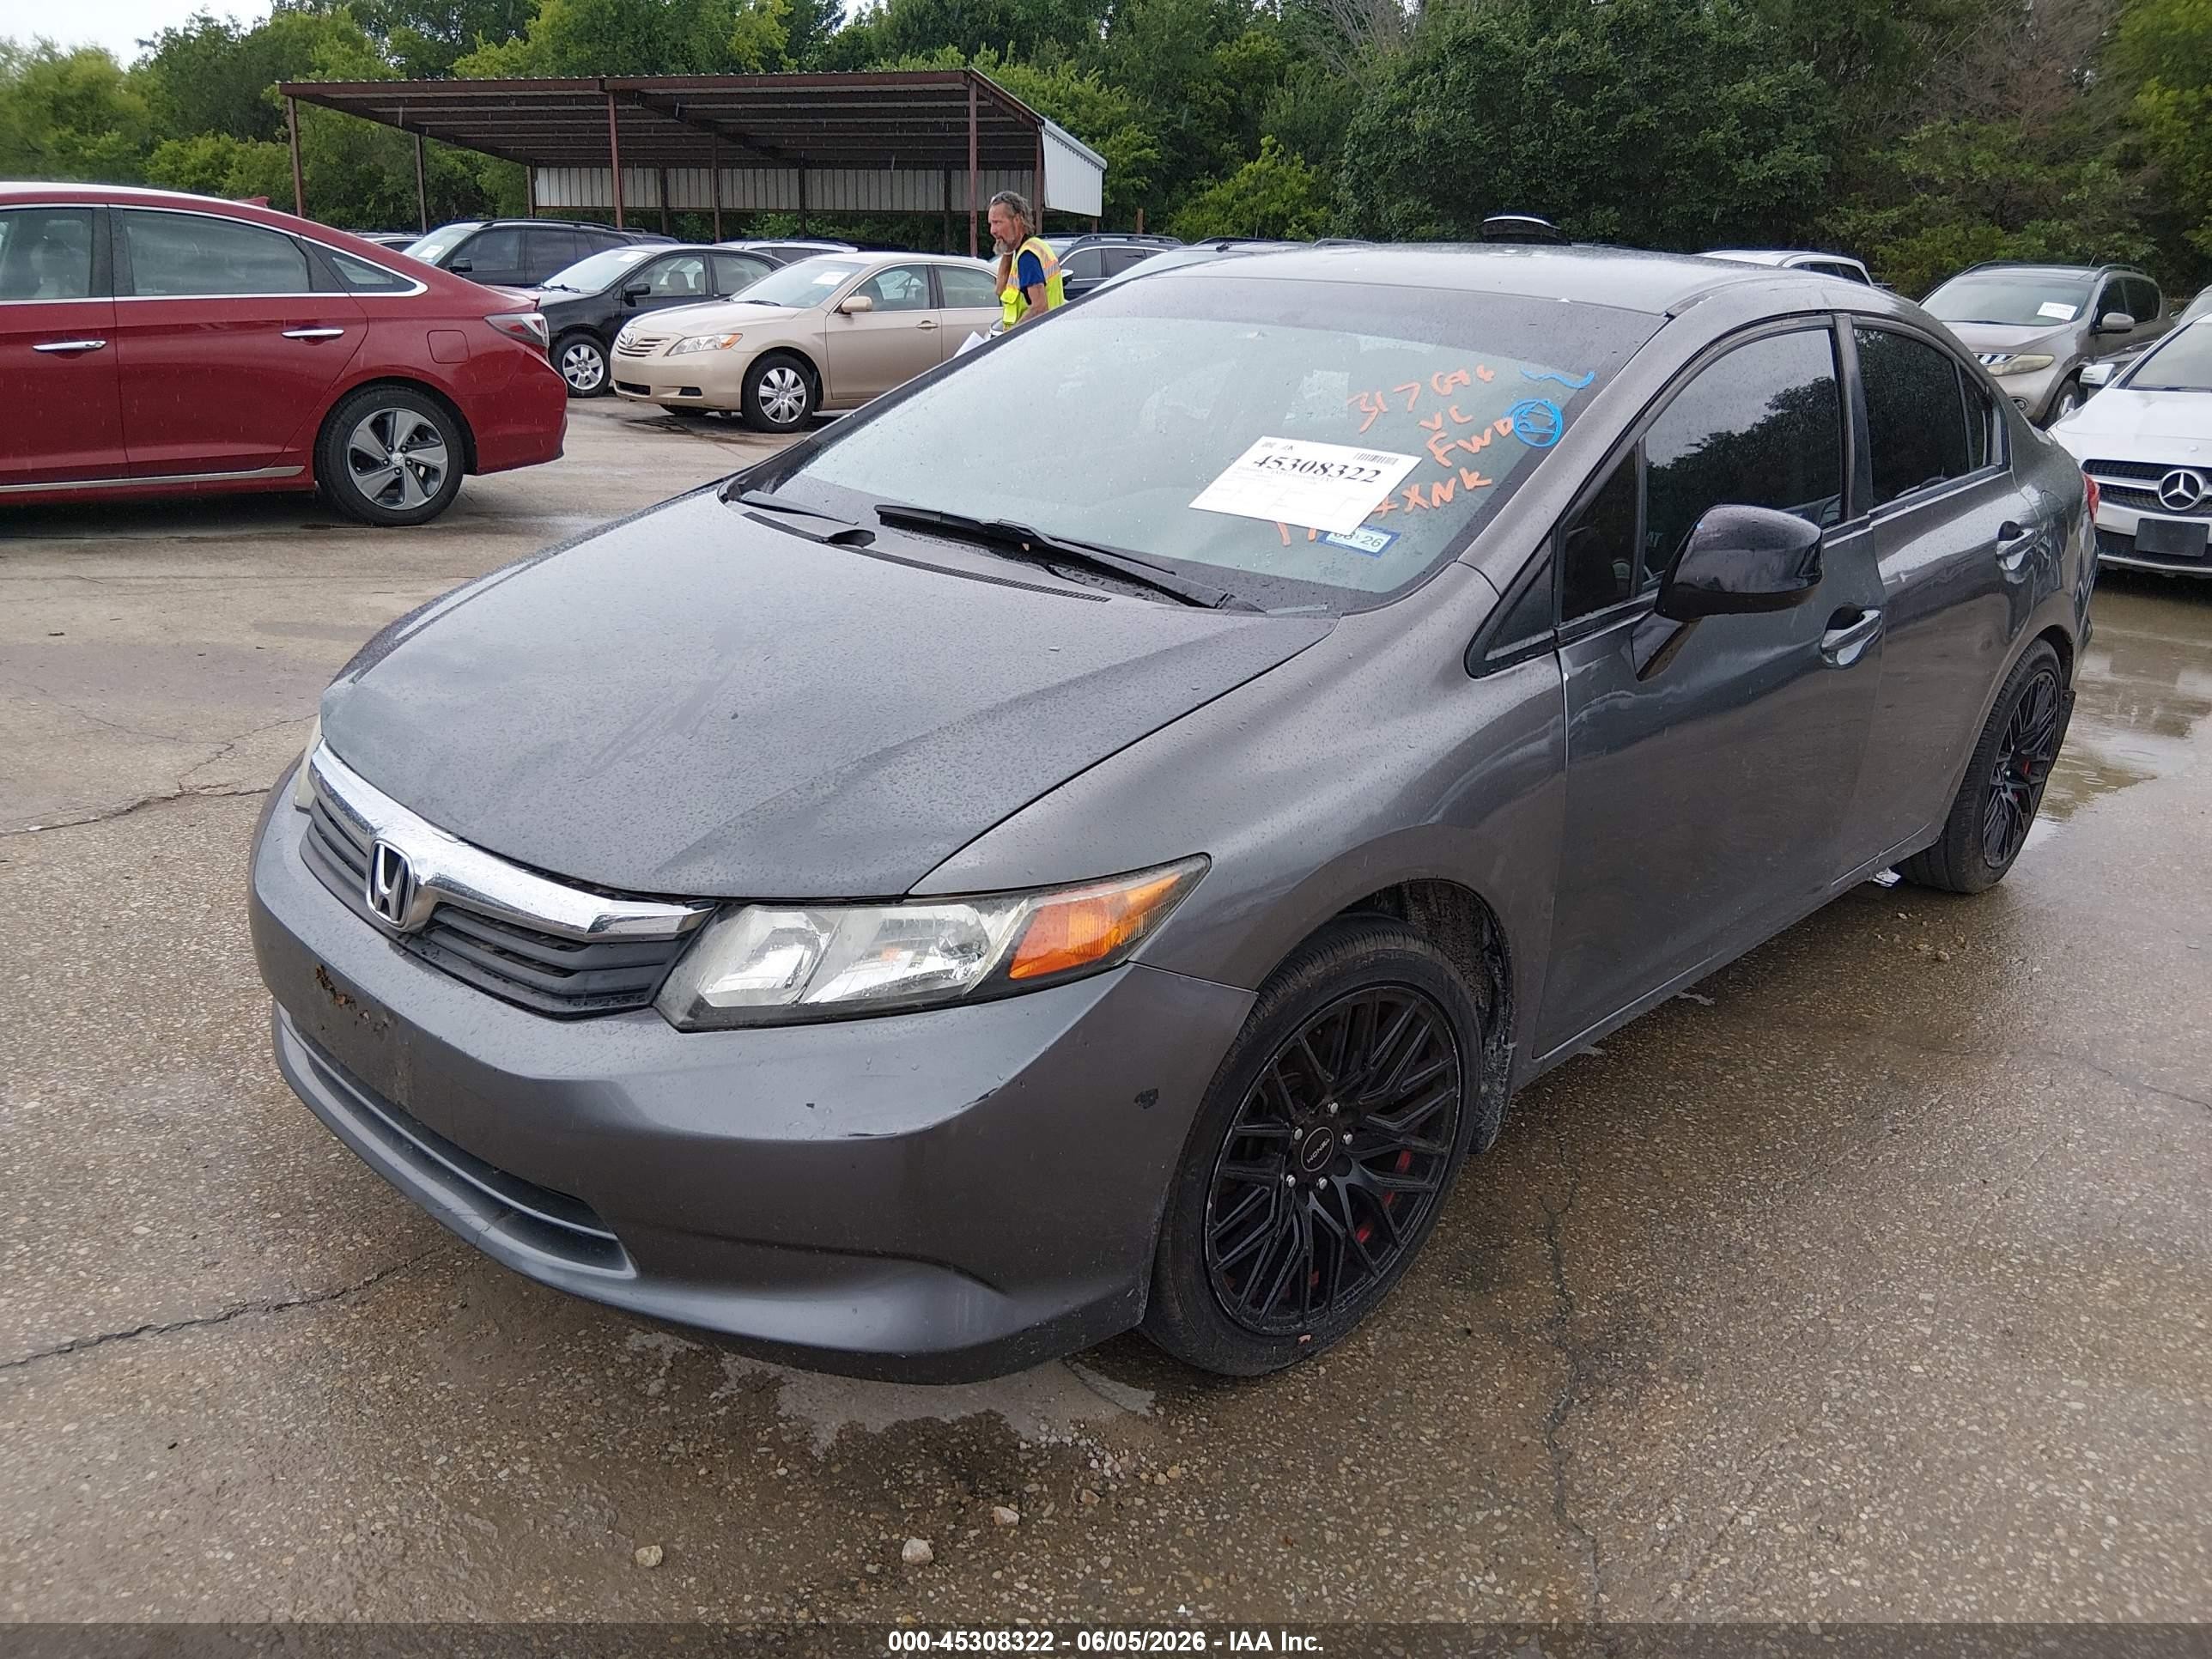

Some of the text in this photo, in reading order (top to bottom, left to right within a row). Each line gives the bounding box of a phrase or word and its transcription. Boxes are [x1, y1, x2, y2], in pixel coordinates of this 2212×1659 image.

[1425, 416, 1514, 467] FWD
[1252, 454, 1382, 483] 45308322
[1360, 535, 1384, 548] 26
